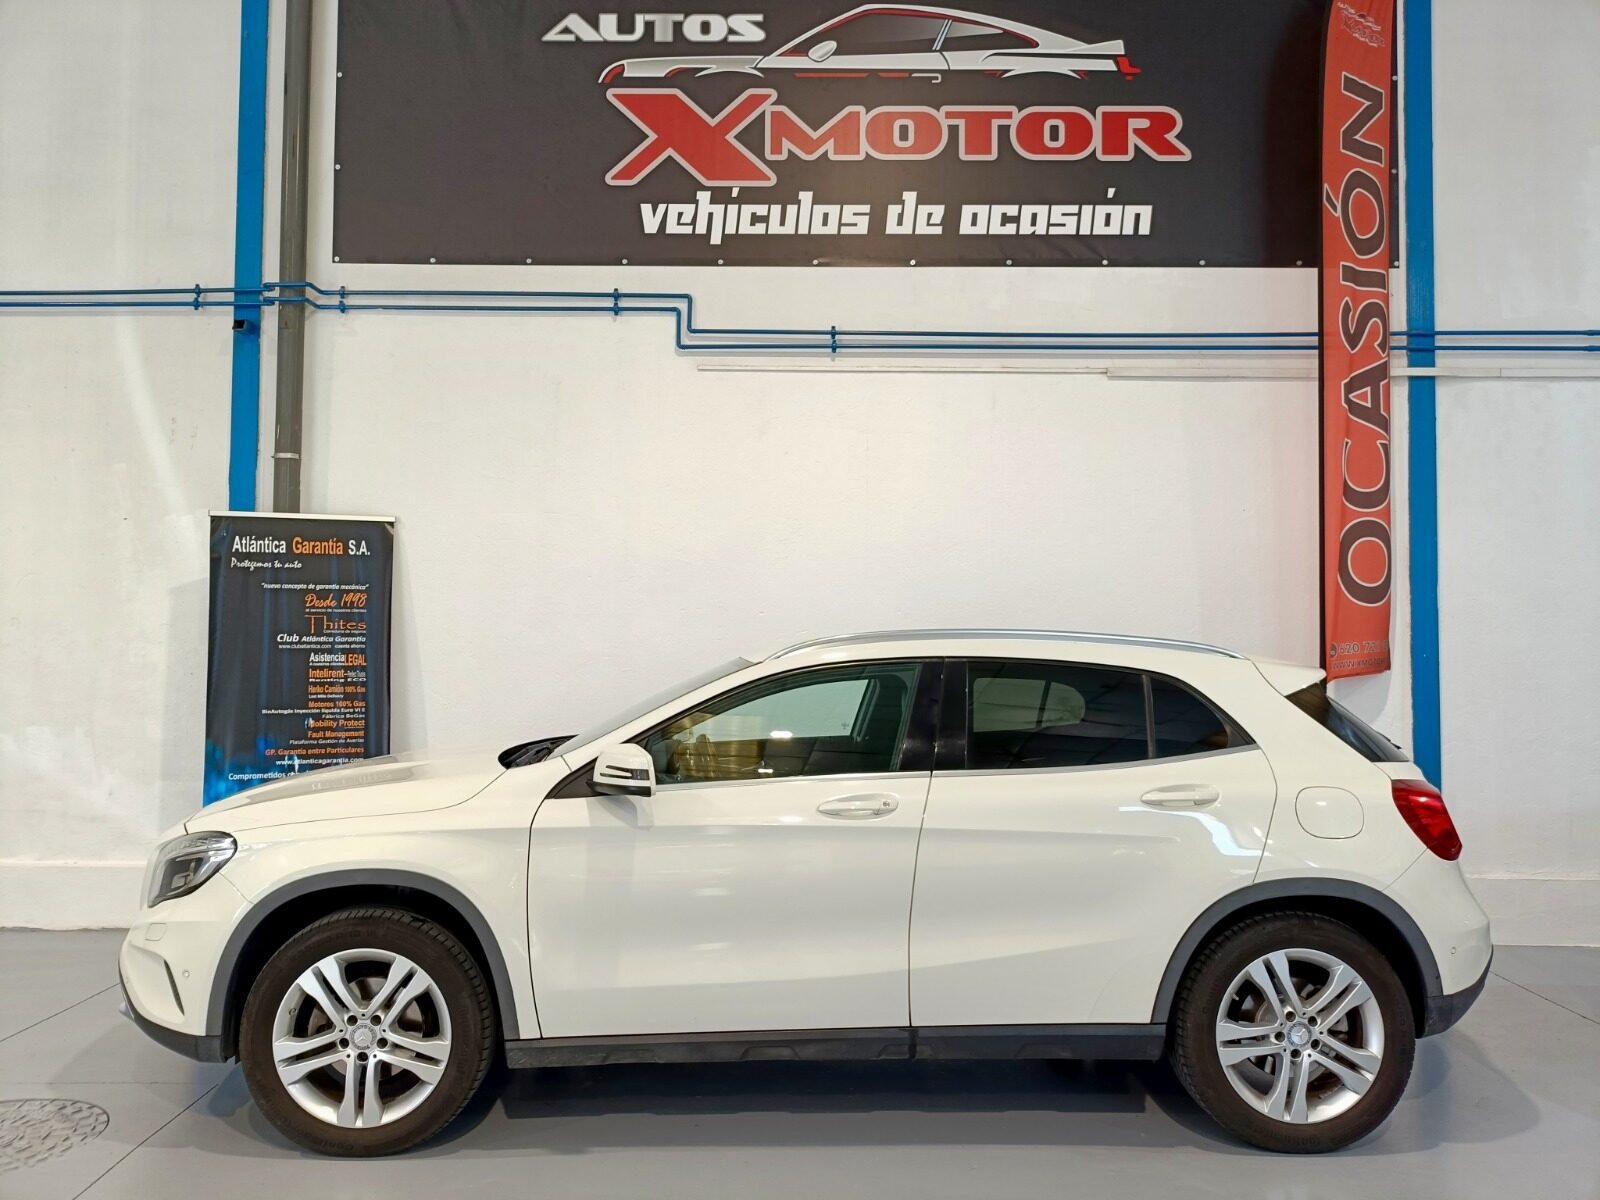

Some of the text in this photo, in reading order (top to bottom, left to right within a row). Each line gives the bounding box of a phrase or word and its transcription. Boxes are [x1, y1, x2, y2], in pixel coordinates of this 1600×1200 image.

[541, 13, 767, 43] AUTOS
[604, 87, 1193, 187] XMOTOR
[640, 187, 1153, 245] vehículos de ocasión
[1323, 71, 1392, 608] OCASIÓN
[231, 535, 371, 556] Atlántica Garantía S.A.
[230, 557, 302, 572] Protegemos tu auto
[281, 583, 307, 591] concepto
[308, 582, 315, 590] de
[304, 592, 368, 608] Desde 1998
[304, 615, 367, 634] Thites
[276, 633, 300, 643] Club
[338, 719, 366, 727] Protect
[307, 730, 325, 738] Fault
[307, 747, 326, 755] entre
[326, 746, 365, 754] Particulares
[228, 771, 286, 782] Comprometidos
